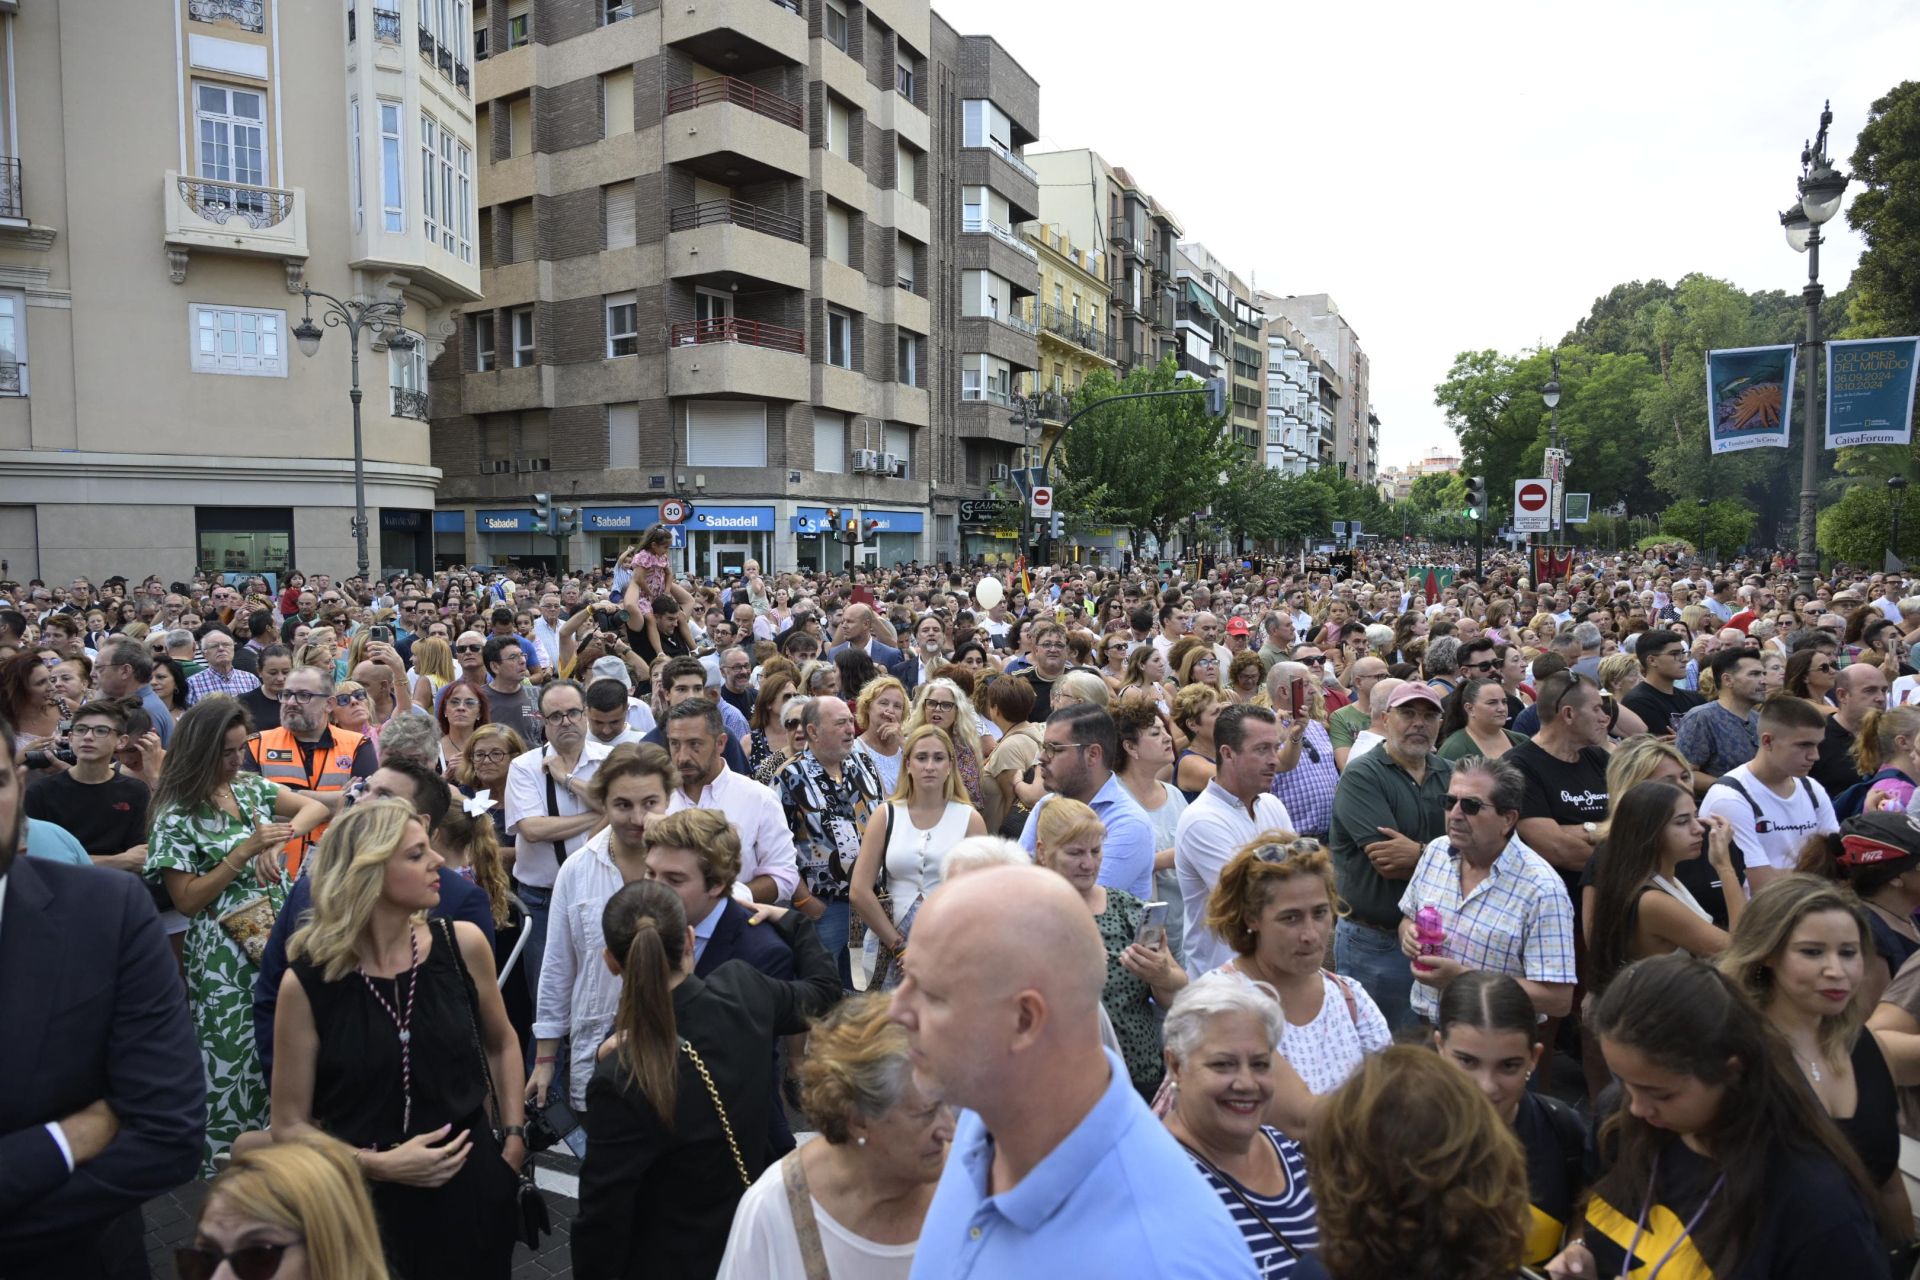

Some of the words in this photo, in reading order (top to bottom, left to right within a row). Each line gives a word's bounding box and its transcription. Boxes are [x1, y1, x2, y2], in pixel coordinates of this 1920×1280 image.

[1834, 351, 1896, 363] COLORES
[1834, 363, 1856, 373] DEL
[1859, 360, 1909, 371] MUNDO
[1835, 434, 1894, 445] CaixaForum
[666, 508, 680, 516] 30
[488, 518, 518, 528] Sabadell
[596, 516, 631, 527] Sabadell
[706, 516, 758, 527] Sabadell
[1561, 790, 1585, 806] Pepe
